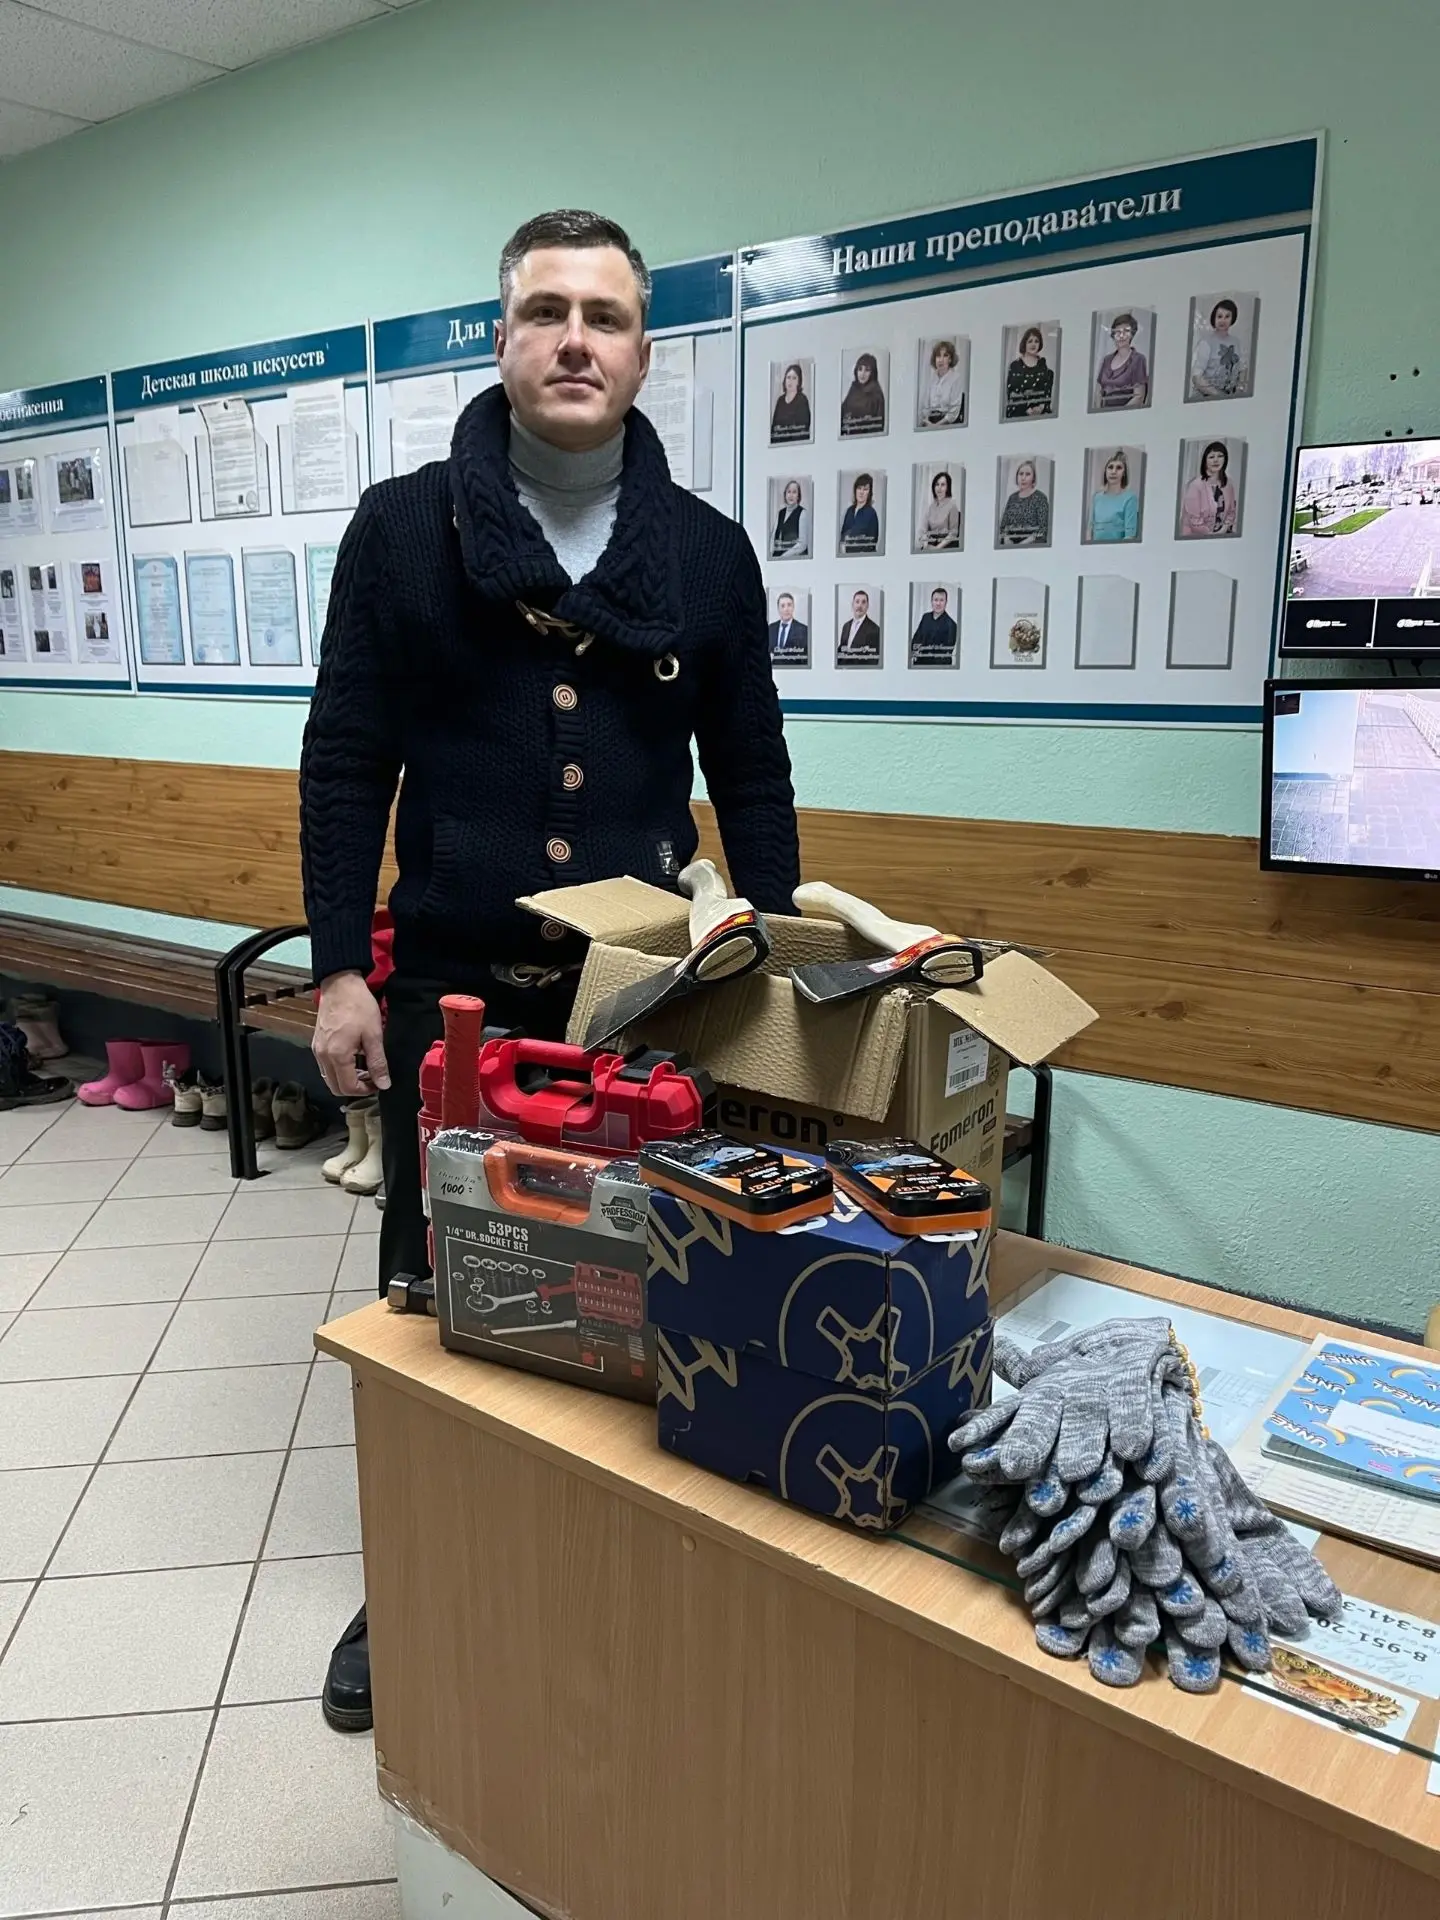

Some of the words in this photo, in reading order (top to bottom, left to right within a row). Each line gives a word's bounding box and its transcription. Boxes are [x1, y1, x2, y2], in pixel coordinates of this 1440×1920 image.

[832, 241, 916, 276] Наши
[926, 188, 1182, 261] преподаватели
[447, 319, 486, 350] Для
[141, 372, 196, 400] Детская
[200, 360, 248, 385] школа
[253, 350, 325, 377] искусств
[930, 1097, 995, 1153] Fomeron
[441, 1182, 465, 1195] 1000
[601, 1206, 646, 1225] PROFESSION
[446, 1225, 464, 1237] 1/4"
[465, 1229, 511, 1249] DR.SOCKET
[513, 1240, 529, 1252] SET
[488, 1221, 529, 1241] 53PCS
